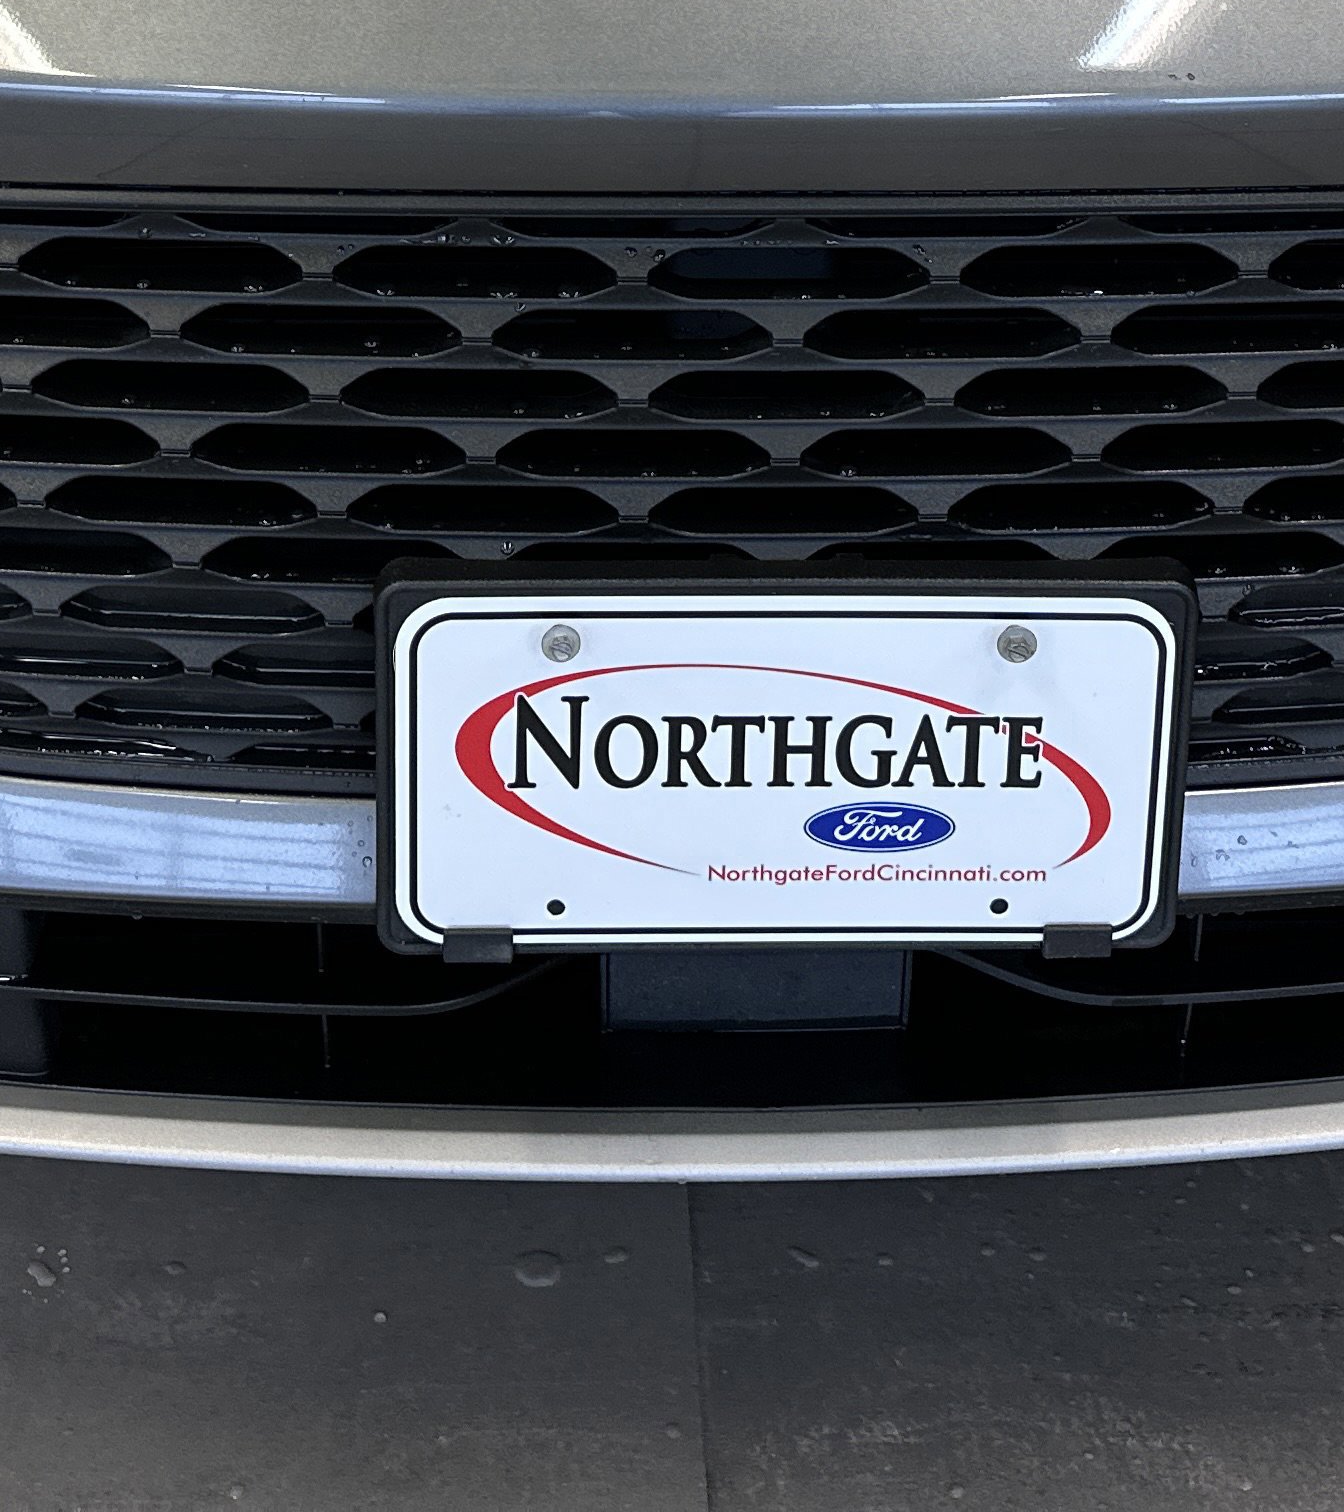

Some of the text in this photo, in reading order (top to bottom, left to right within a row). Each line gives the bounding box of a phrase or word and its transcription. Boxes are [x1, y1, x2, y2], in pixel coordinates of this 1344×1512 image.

[506, 695, 1044, 789] NORTHGATE
[834, 808, 924, 842] Ford
[709, 864, 1047, 885] NorthgateFordCincinnati.com
